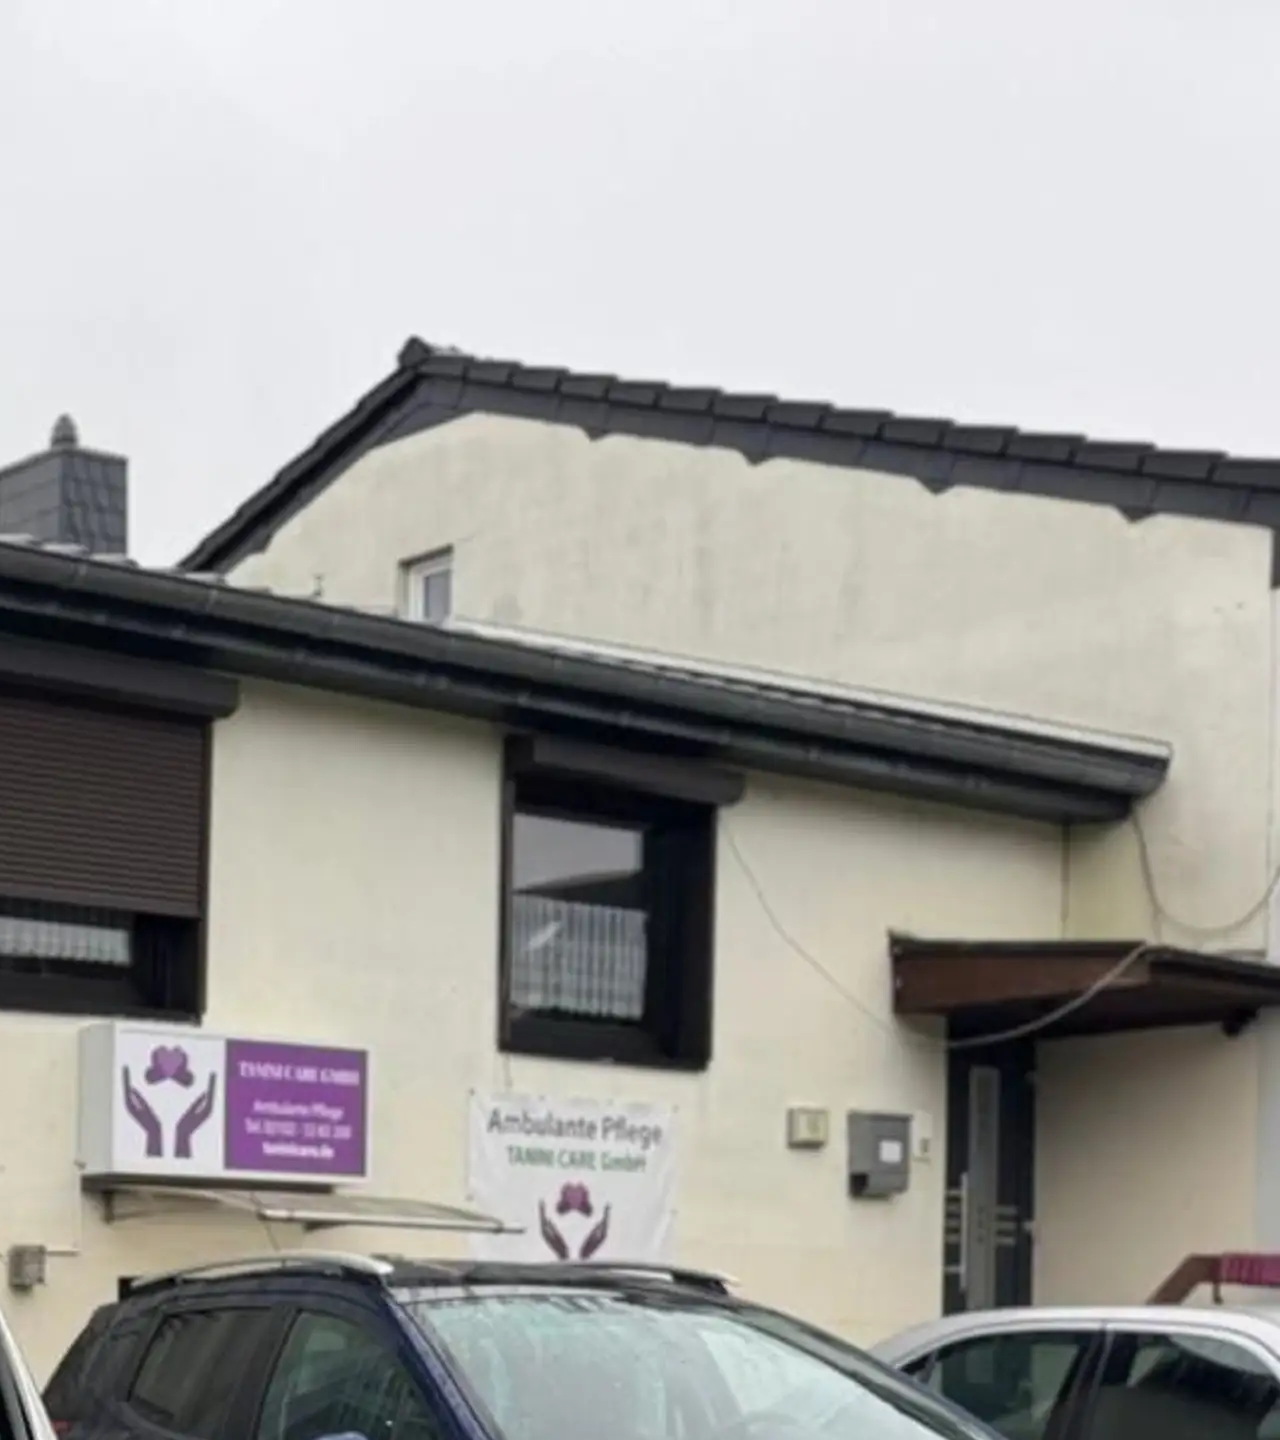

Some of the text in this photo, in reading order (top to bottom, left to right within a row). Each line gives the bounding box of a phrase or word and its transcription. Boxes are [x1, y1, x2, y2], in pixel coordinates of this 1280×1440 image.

[487, 1108, 662, 1150] Ambulante Pflege
[557, 1149, 596, 1170] CARE
